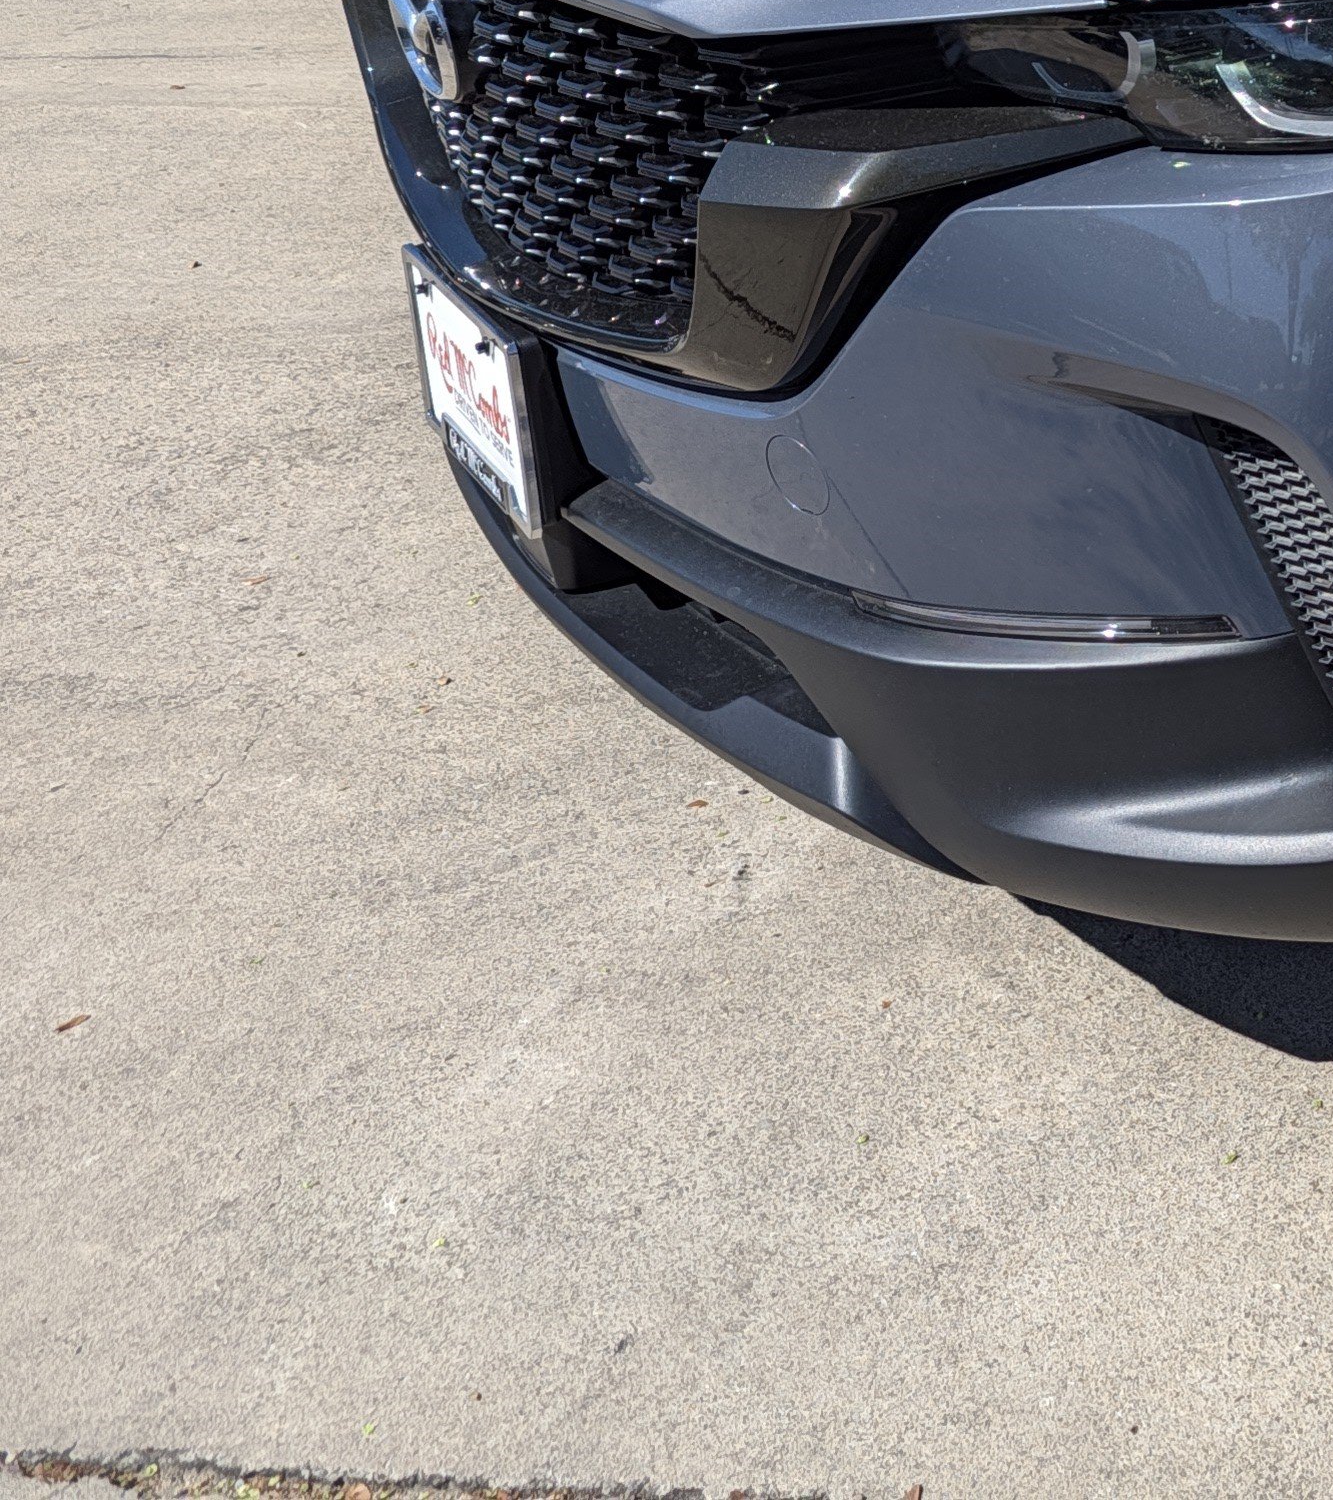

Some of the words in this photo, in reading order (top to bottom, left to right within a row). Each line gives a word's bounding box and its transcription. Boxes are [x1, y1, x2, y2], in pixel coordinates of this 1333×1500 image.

[427, 312, 453, 394] Red
[449, 340, 510, 445] McCombs
[453, 388, 479, 429] DRIVEN
[480, 421, 490, 441] TO
[491, 433, 514, 467] SERVE
